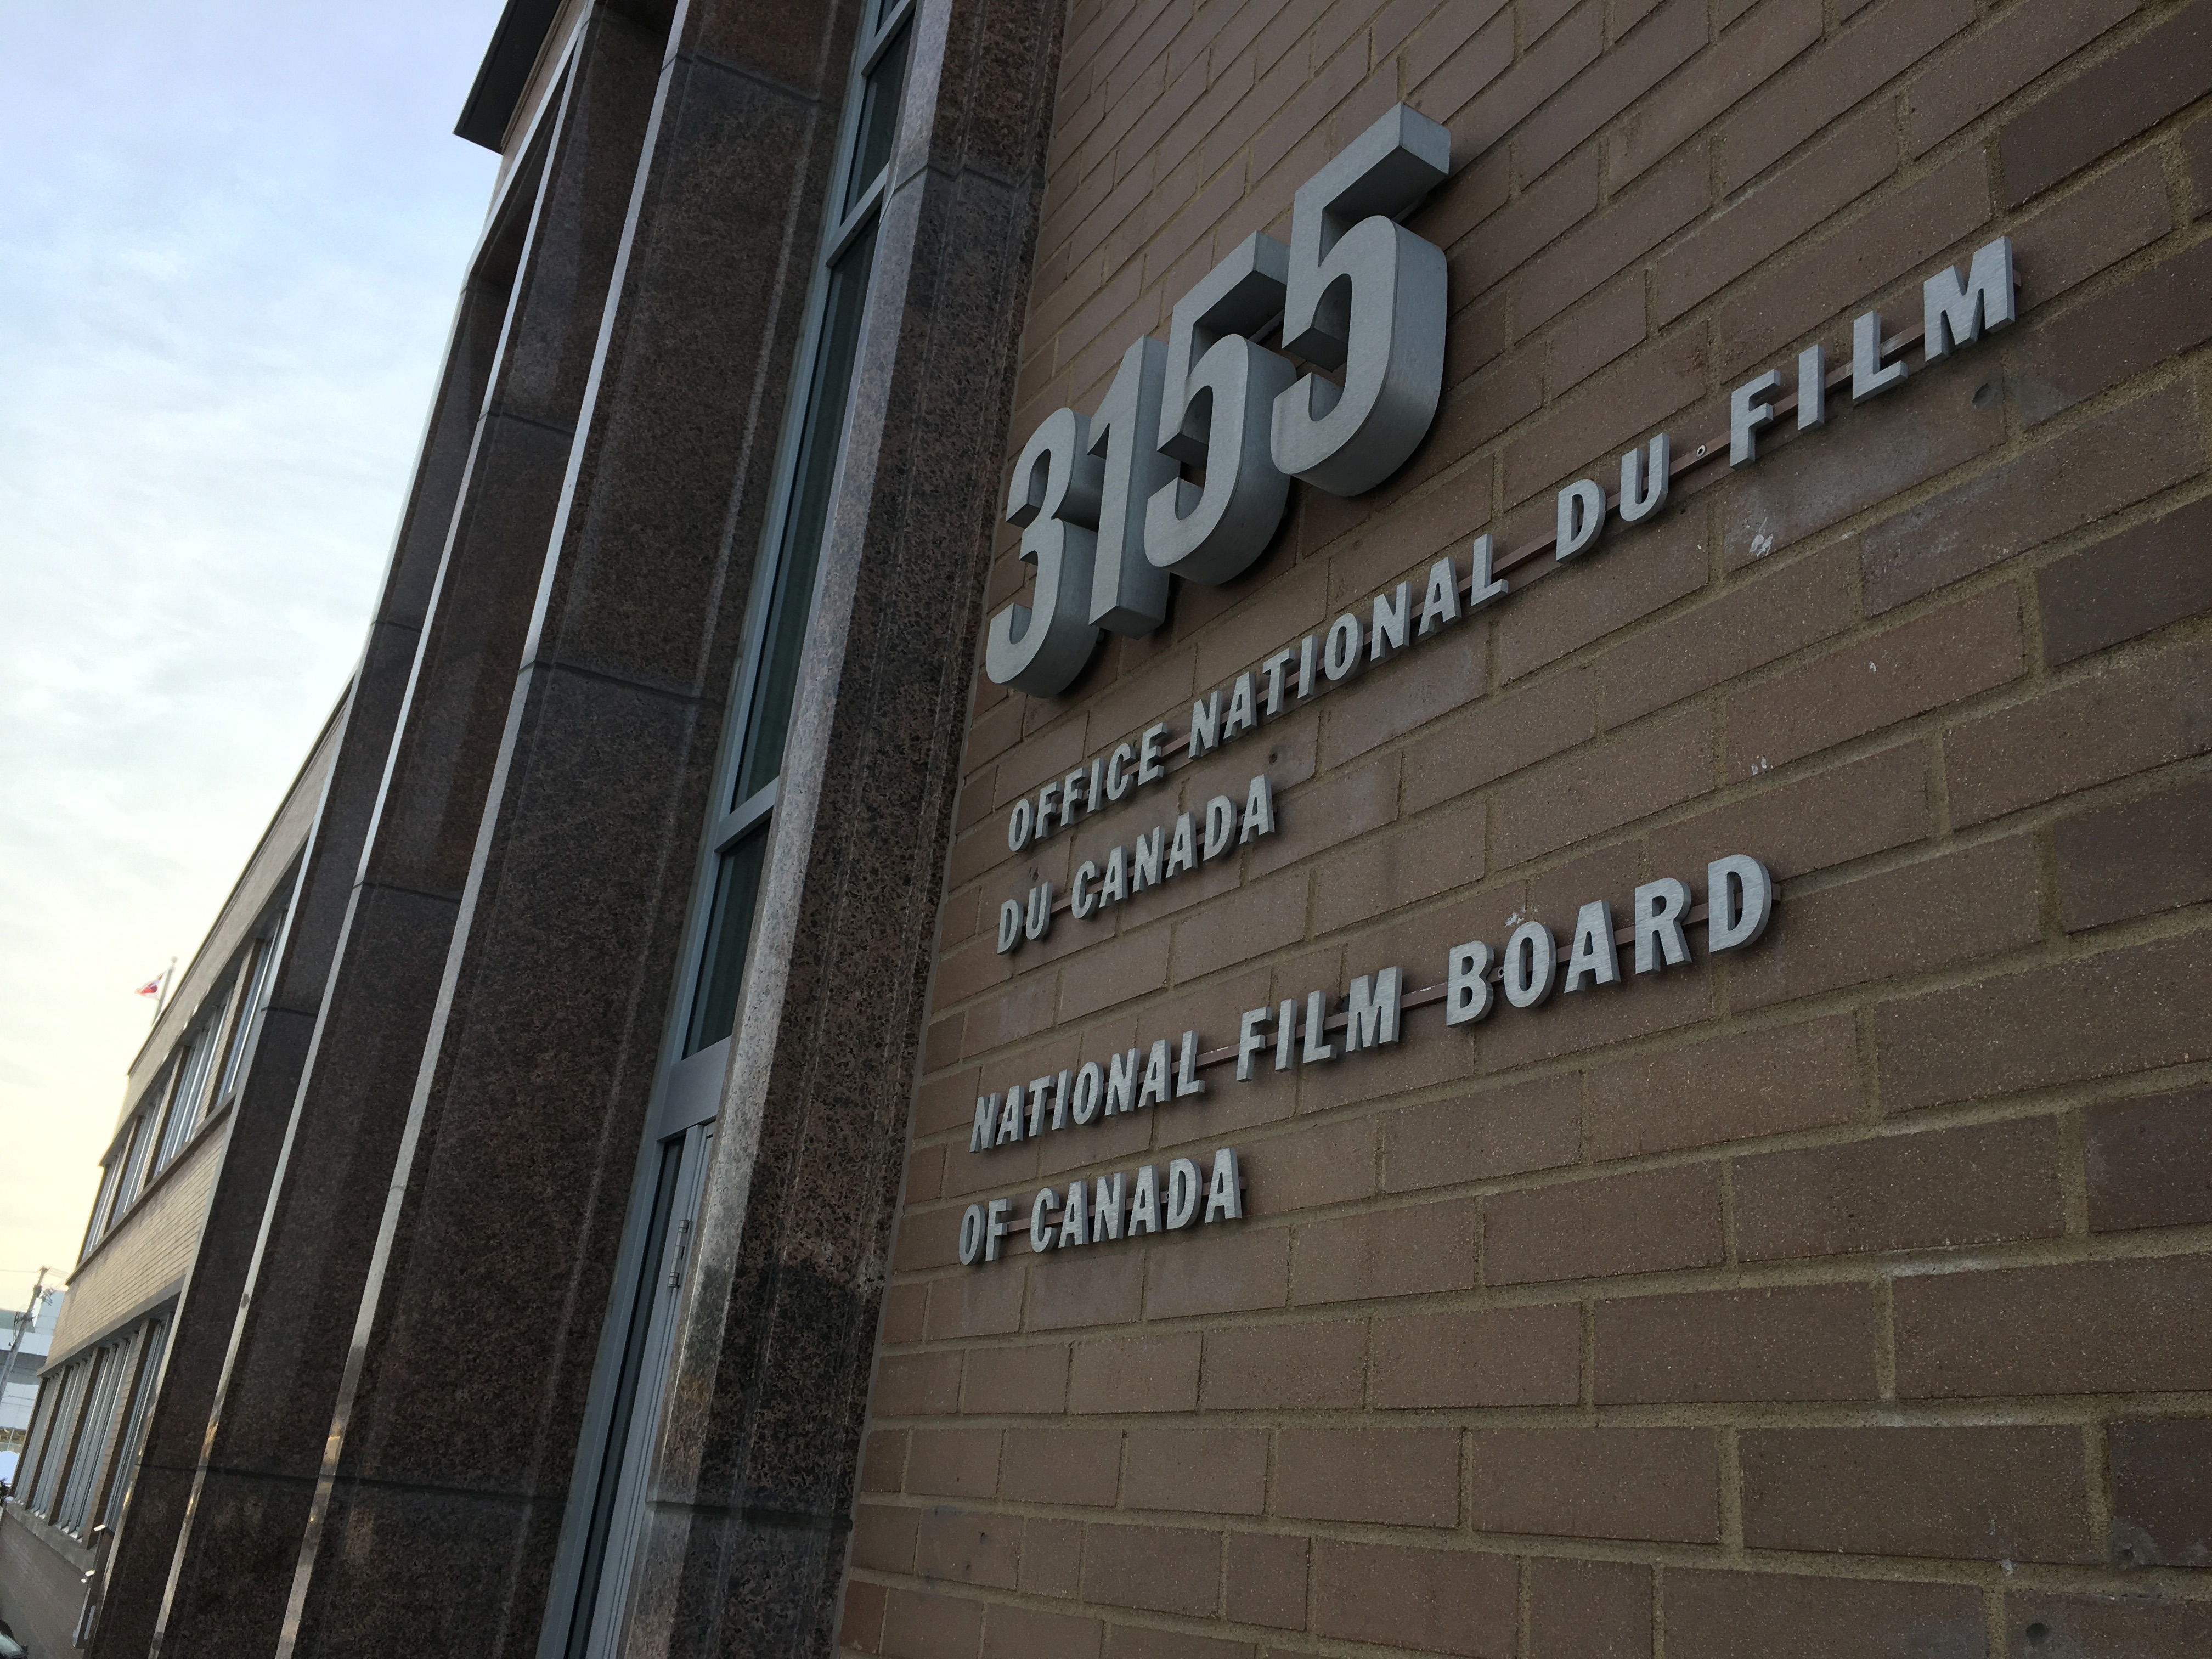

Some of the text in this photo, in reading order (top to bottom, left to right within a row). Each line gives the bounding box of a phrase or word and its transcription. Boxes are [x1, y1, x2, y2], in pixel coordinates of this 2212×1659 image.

[986, 101, 1451, 699] 3155
[1008, 235, 2015, 852] OFFICE NATIONAL DU FILM
[969, 854, 1772, 1153] NATIONAL FILM BOARD
[997, 773, 1275, 955] DU CANADA
[959, 1147, 1242, 1265] OF CANADA
